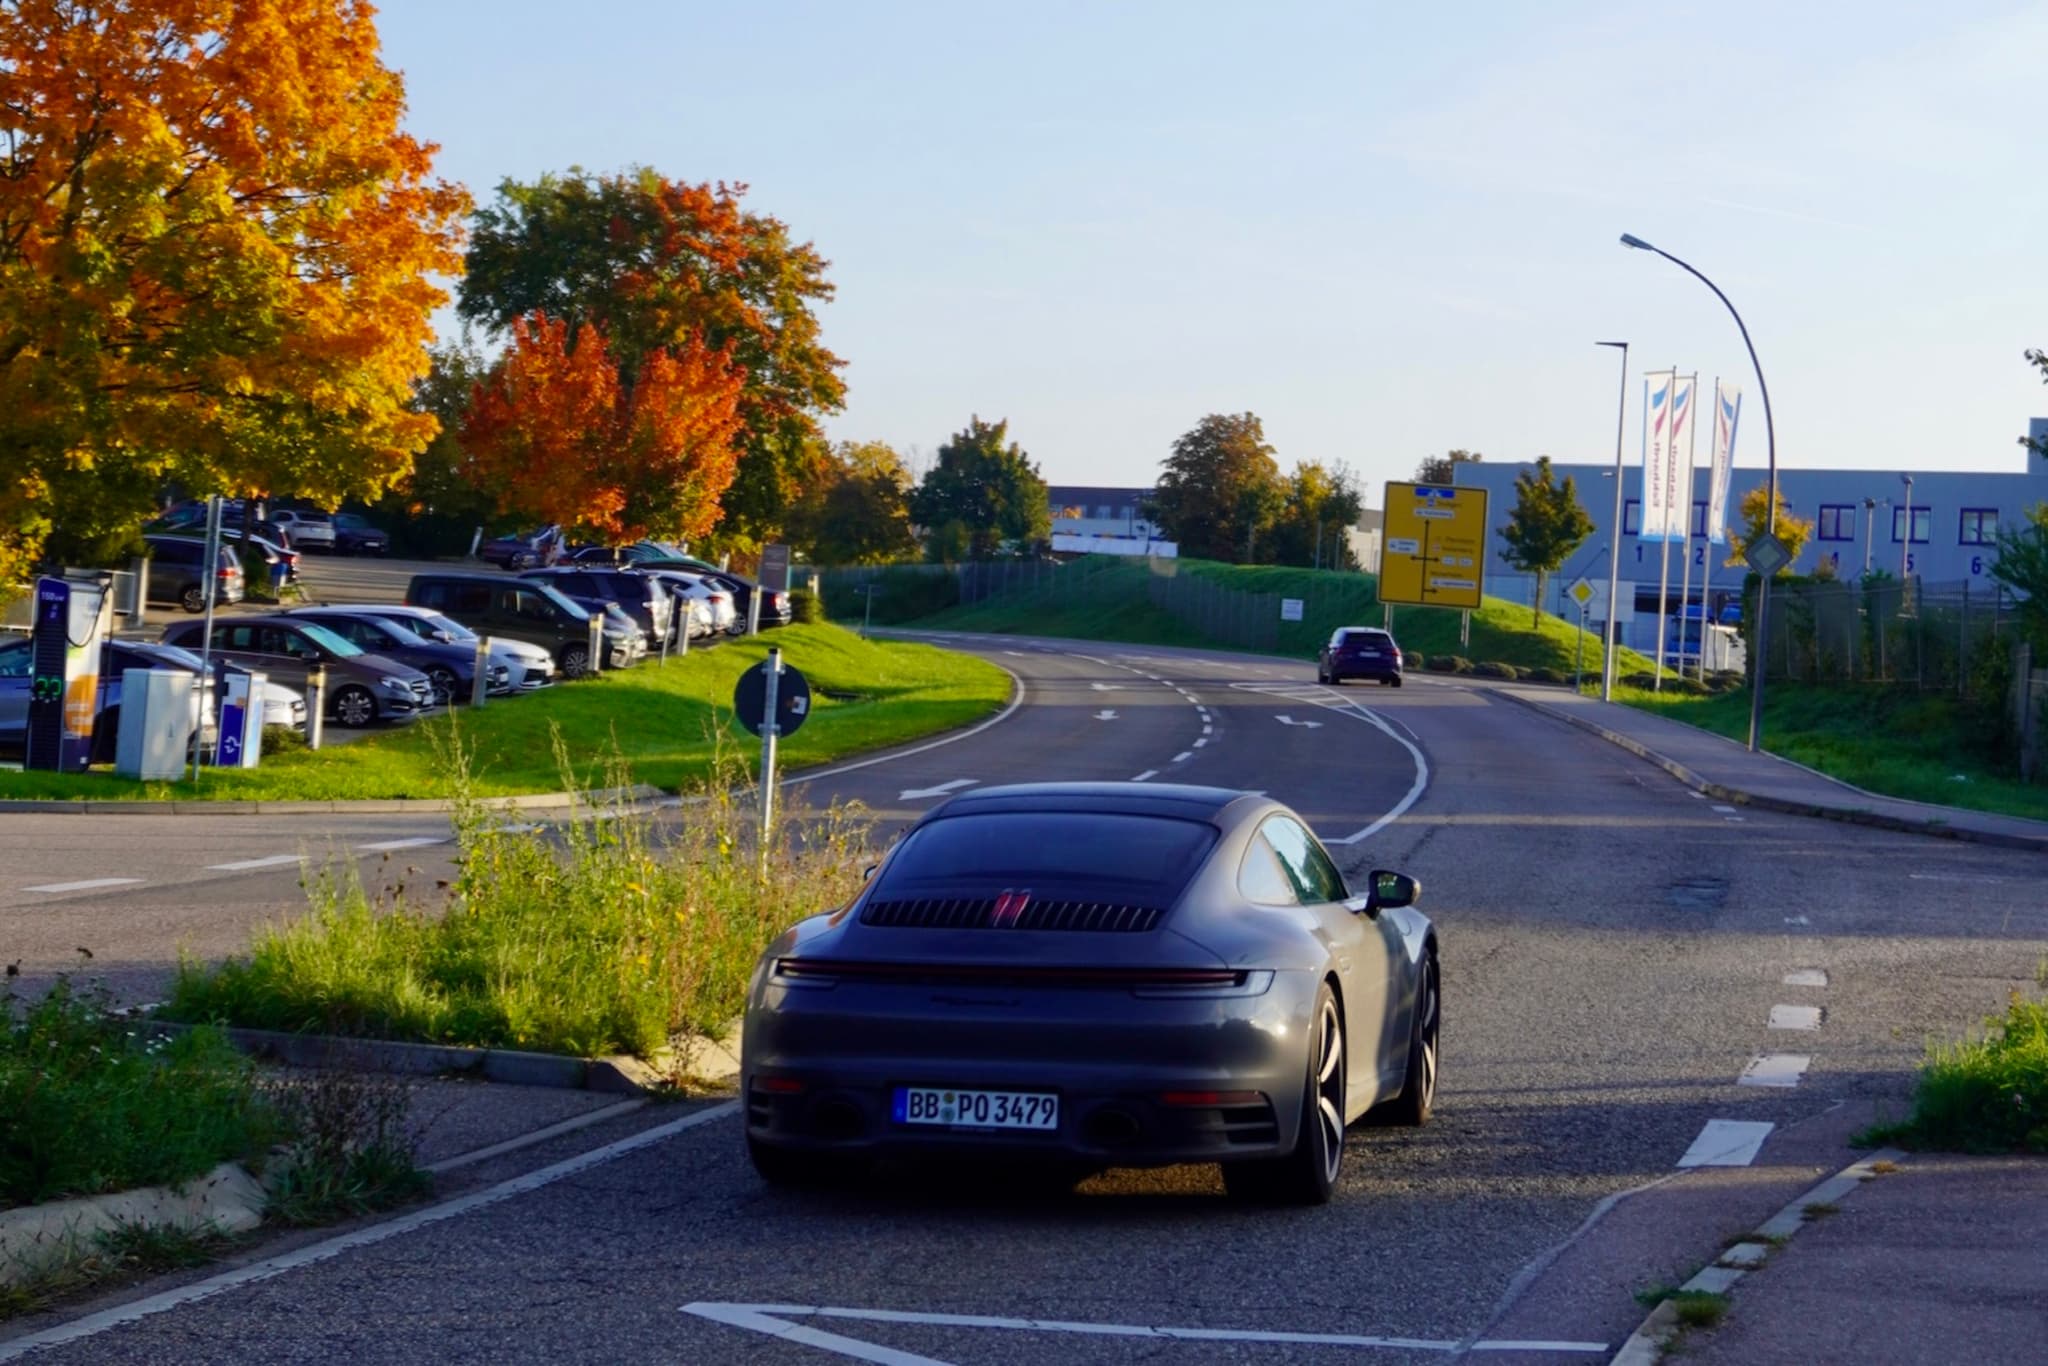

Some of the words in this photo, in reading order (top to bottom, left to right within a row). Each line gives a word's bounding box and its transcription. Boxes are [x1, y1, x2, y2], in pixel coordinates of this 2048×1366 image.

[1636, 545, 1642, 563] 1
[1696, 547, 1704, 565] 2
[1972, 557, 1981, 575] 6
[909, 1092, 939, 1119] BB
[957, 1094, 989, 1123] PO
[994, 1095, 1055, 1125] 3479
